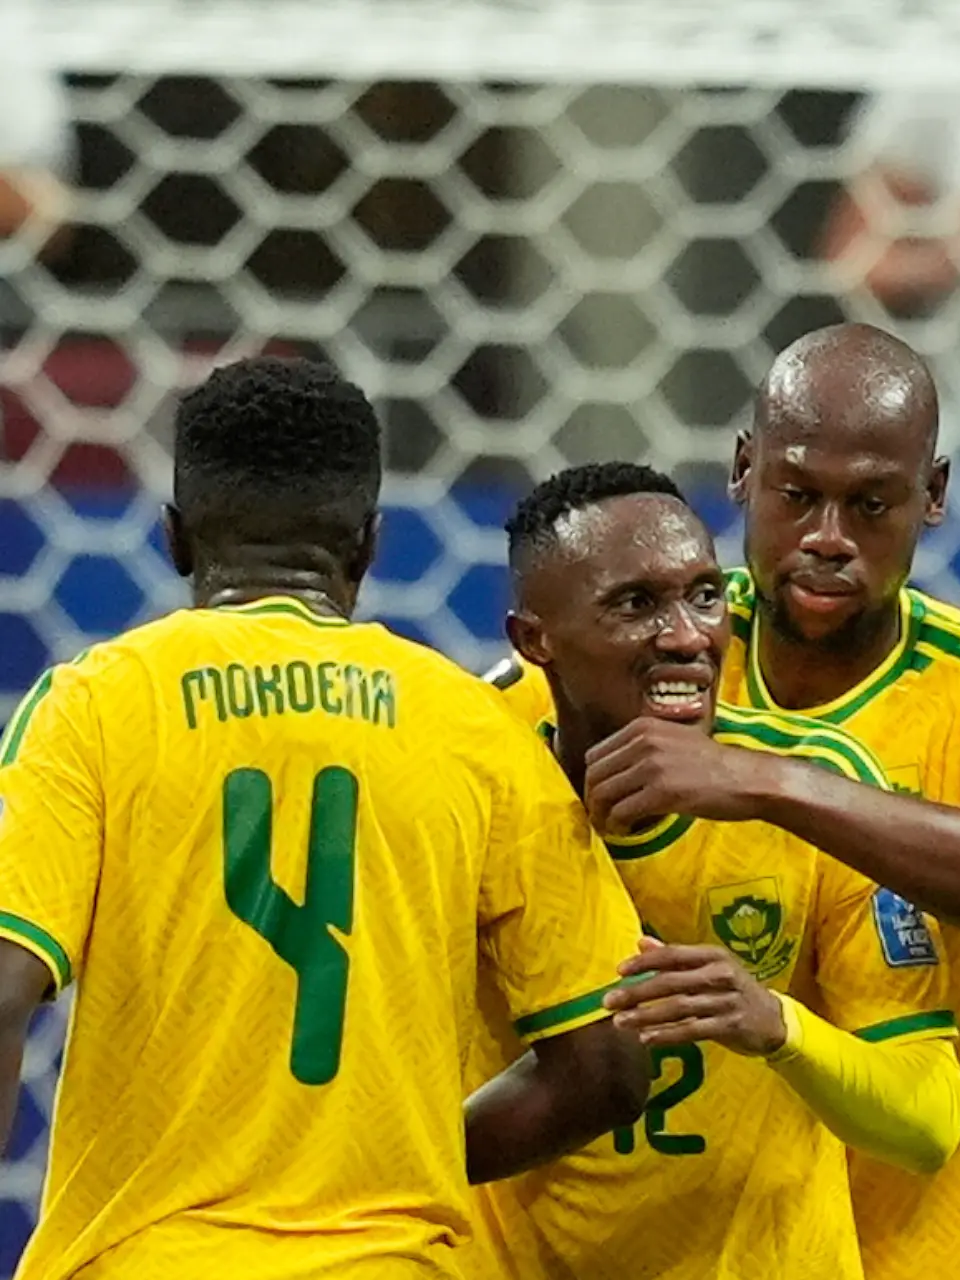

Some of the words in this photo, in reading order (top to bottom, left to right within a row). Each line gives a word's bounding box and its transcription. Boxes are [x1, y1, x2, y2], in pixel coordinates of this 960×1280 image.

[181, 660, 396, 730] MOKOENA
[222, 764, 359, 1087] 4
[613, 1042, 707, 1155] 2
